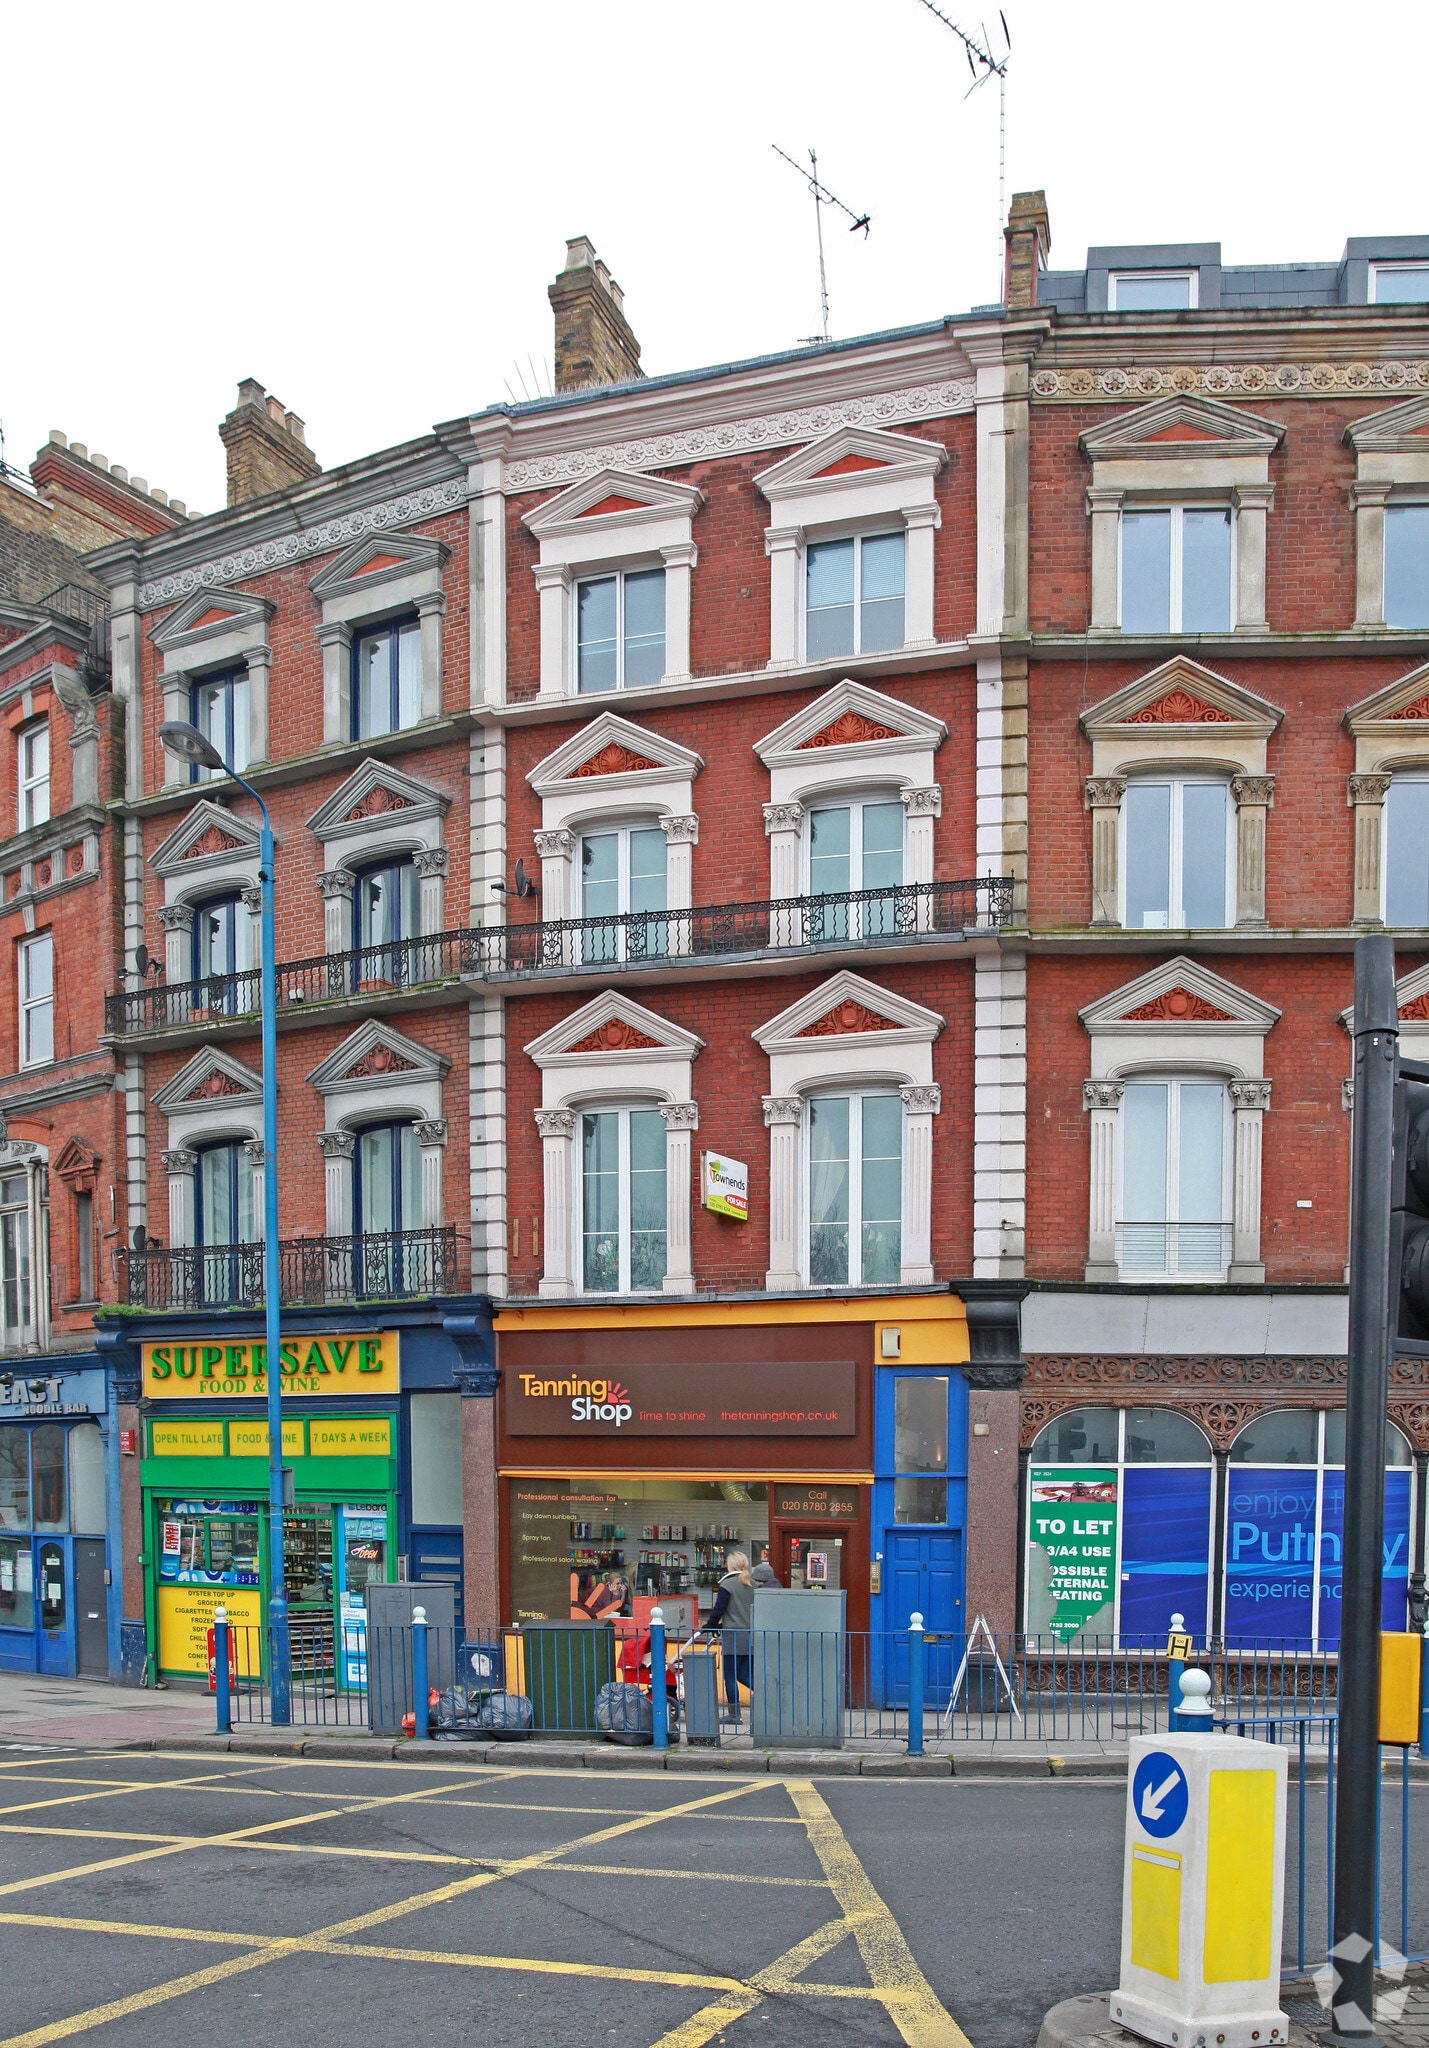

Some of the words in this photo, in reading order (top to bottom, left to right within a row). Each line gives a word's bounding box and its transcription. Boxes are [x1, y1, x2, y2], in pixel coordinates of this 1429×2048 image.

[711, 1169, 745, 1191] Townends
[726, 1195, 736, 1205] FOR
[736, 1198, 747, 1209] SALE
[151, 1338, 384, 1379] SUPERSAVE
[199, 1379, 247, 1394] FOOD
[253, 1378, 266, 1393] &
[518, 1373, 607, 1402] Tanning
[22, 1403, 62, 1414] NOODLE
[65, 1402, 88, 1413] BAR
[571, 1396, 632, 1427] Shop
[639, 1411, 662, 1421] Time
[666, 1411, 677, 1421] to
[679, 1411, 706, 1421] shine
[721, 1410, 838, 1423] thetanningshop.co.uk
[154, 1433, 179, 1444] OPEN
[181, 1433, 199, 1444] TILL
[201, 1433, 223, 1444] LATE
[236, 1433, 262, 1444] FOOD
[282, 1433, 297, 1443] INE
[313, 1433, 319, 1443] 7
[321, 1432, 347, 1443] DAYS
[349, 1433, 357, 1443] A
[358, 1432, 388, 1442] WEEK
[517, 1492, 558, 1501] Professional
[561, 1494, 604, 1502] consultation
[808, 1490, 828, 1500] Call
[781, 1501, 800, 1511] 020
[802, 1501, 827, 1511] 8780
[829, 1502, 853, 1512] 2855
[1232, 1489, 1316, 1520] enjoy
[522, 1512, 533, 1520] Lay
[552, 1513, 577, 1521] sunbeds
[1036, 1518, 1066, 1534] TO
[1072, 1519, 1113, 1535] LET
[521, 1534, 540, 1542] Spray
[1046, 1545, 1078, 1557] 3/A4
[1081, 1546, 1112, 1557] USE
[1232, 1521, 1406, 1572] Putny
[358, 1549, 379, 1560] OPEN
[522, 1555, 558, 1563] Professional
[576, 1557, 598, 1565] waxing
[1050, 1566, 1108, 1577] OSSIBLE
[1048, 1578, 1109, 1589] XTERNAL
[1051, 1590, 1103, 1601] EATING
[1229, 1579, 1343, 1602] experienc
[197, 1599, 226, 1607] GROCERY
[175, 1607, 213, 1615] CIGARETTES
[225, 1609, 250, 1617] OBACCO
[517, 1609, 544, 1619] Tanning
[1169, 1635, 1190, 1658] H
